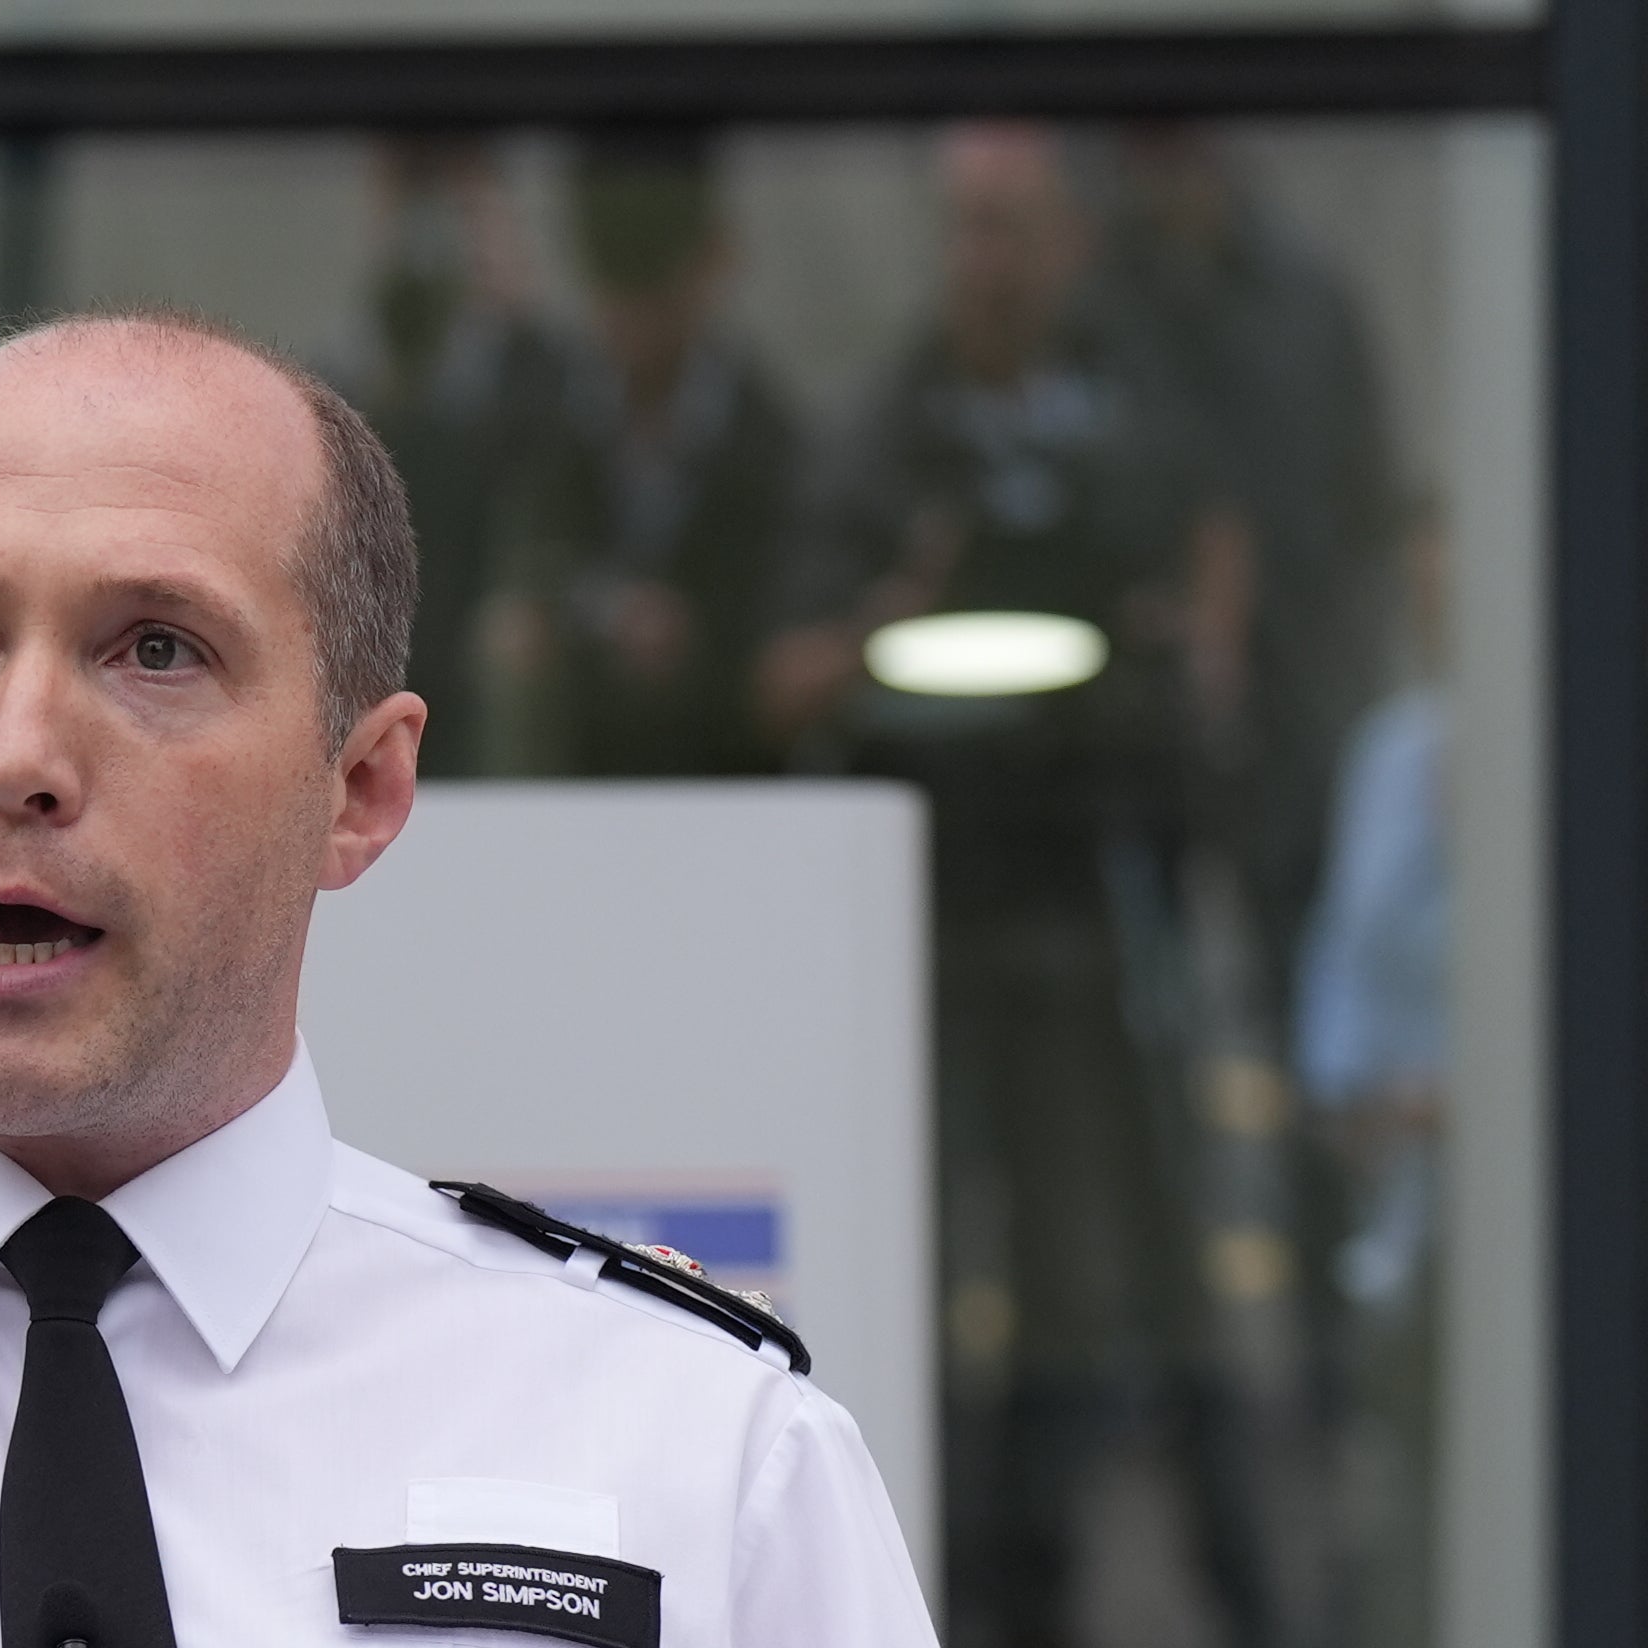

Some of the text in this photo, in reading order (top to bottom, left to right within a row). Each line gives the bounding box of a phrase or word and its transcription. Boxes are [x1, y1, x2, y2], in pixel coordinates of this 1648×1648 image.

[402, 1561, 608, 1595] CHIEF SUPERINTENDENT
[413, 1580, 600, 1620] JON SIMPSON
